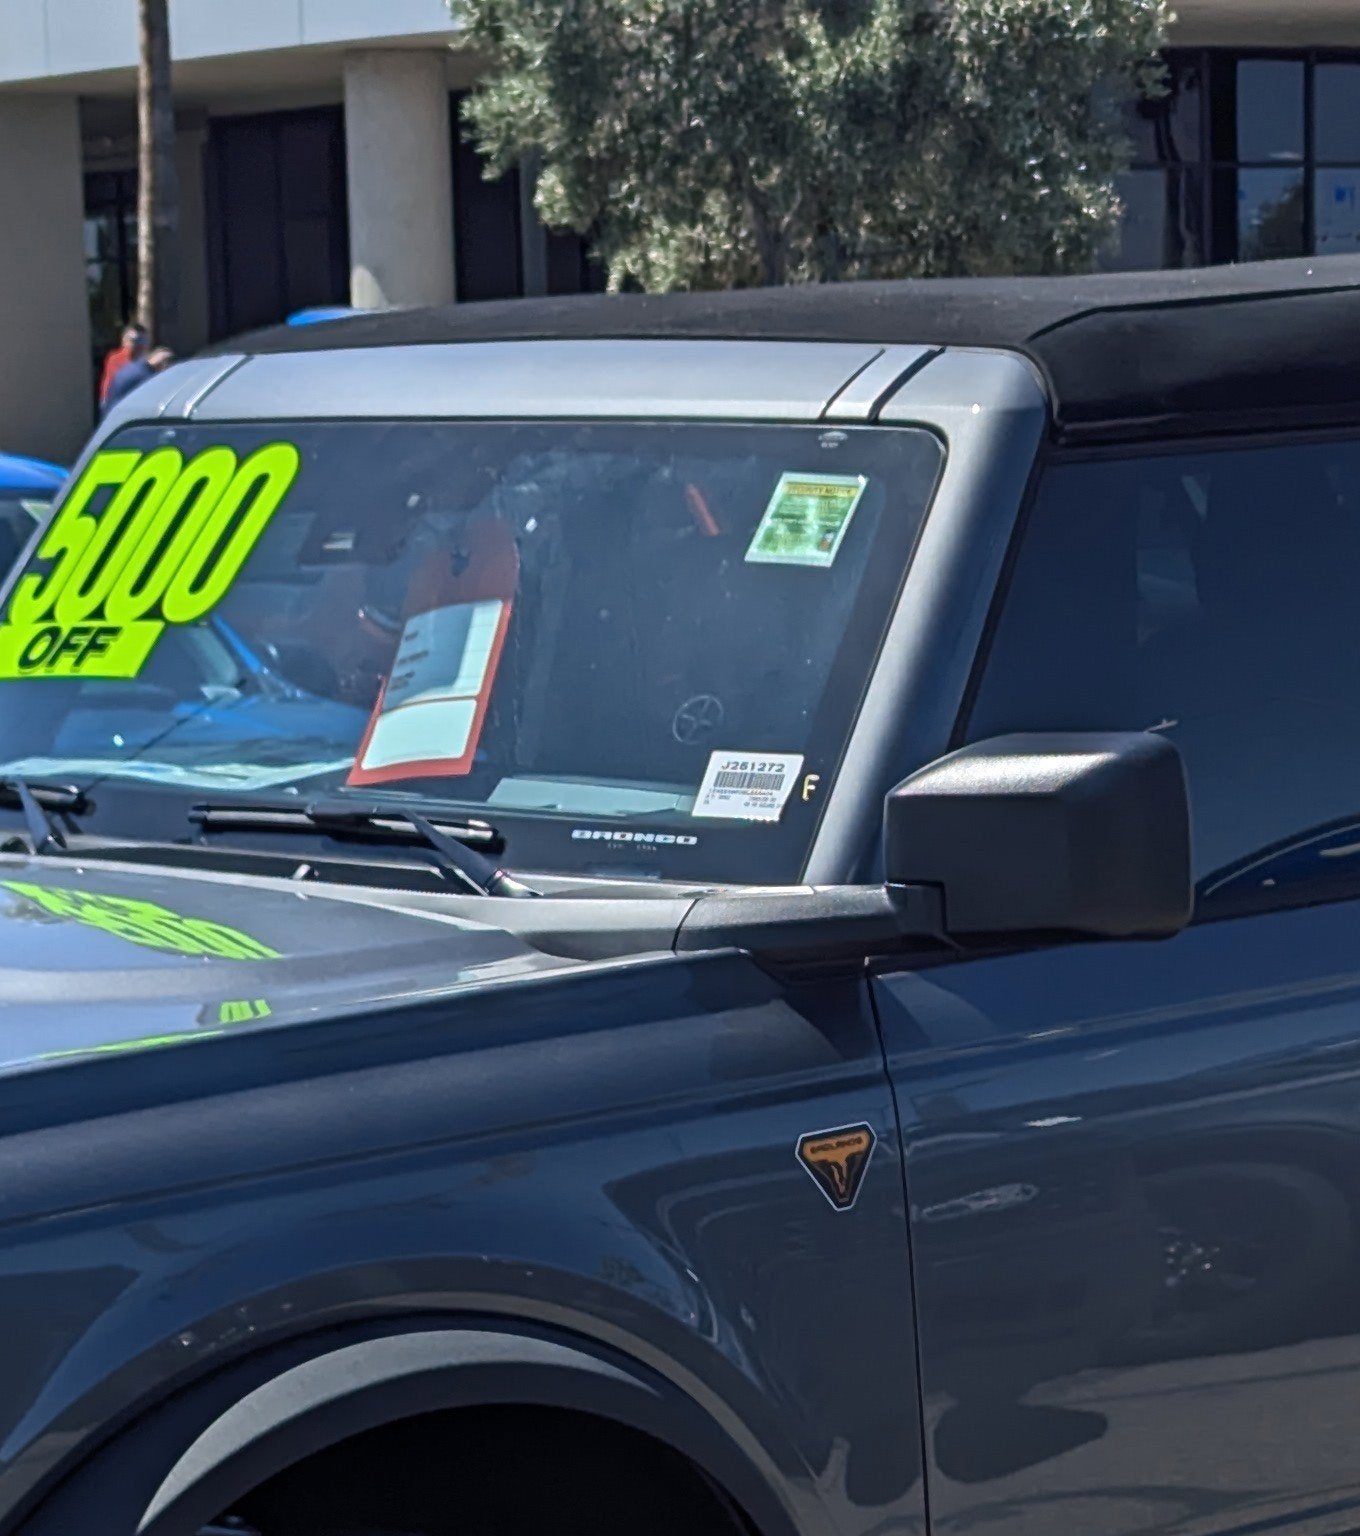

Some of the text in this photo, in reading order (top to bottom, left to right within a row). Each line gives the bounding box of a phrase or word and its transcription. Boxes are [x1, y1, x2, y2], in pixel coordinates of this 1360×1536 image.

[7, 443, 299, 626] 5000
[17, 625, 124, 673] OFF
[571, 829, 698, 844] BRONCO
